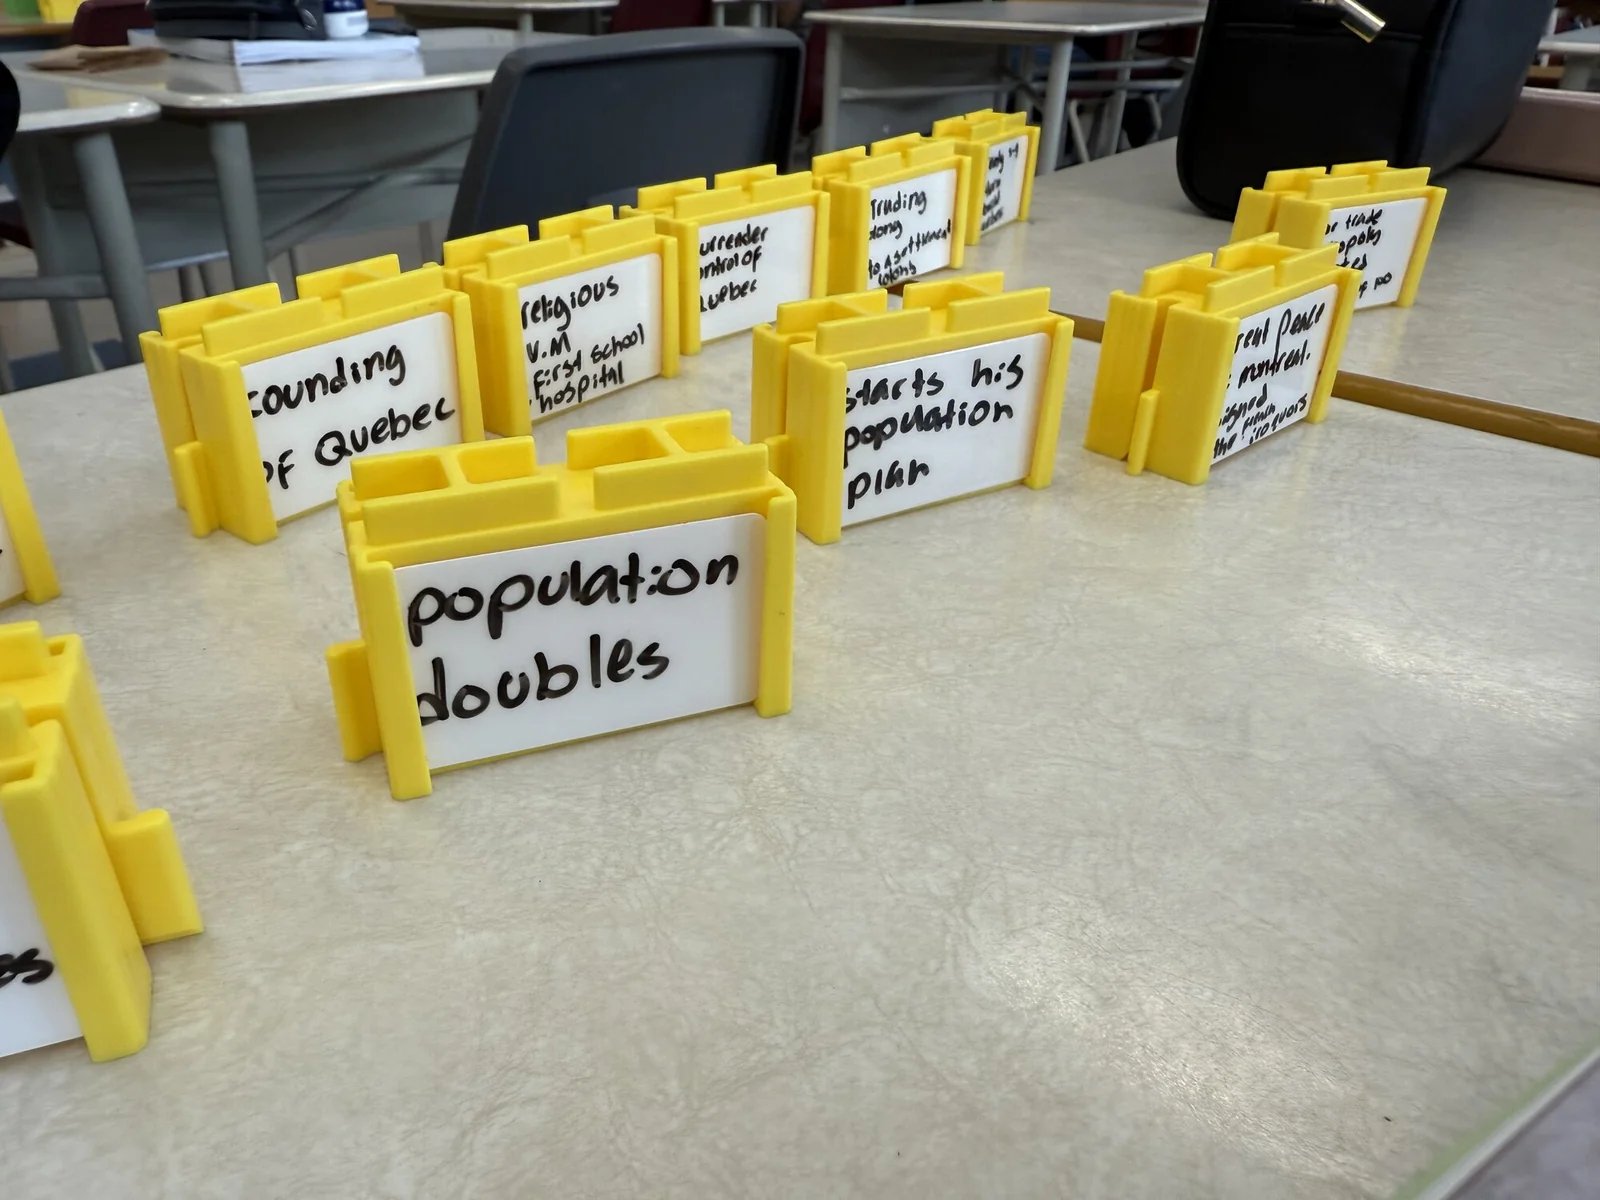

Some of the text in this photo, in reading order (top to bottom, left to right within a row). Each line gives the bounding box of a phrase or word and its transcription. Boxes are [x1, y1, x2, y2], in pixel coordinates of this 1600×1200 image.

[699, 223, 769, 257] urrender
[520, 275, 620, 332] religious
[539, 360, 625, 414] hospital
[845, 353, 1025, 415] starts his
[1218, 383, 1268, 433] igned
[314, 397, 456, 467] Quebec
[843, 398, 1014, 470] population
[1213, 432, 1238, 459] the
[847, 458, 931, 510] plan
[407, 552, 740, 648] population
[416, 633, 671, 727] doubles
